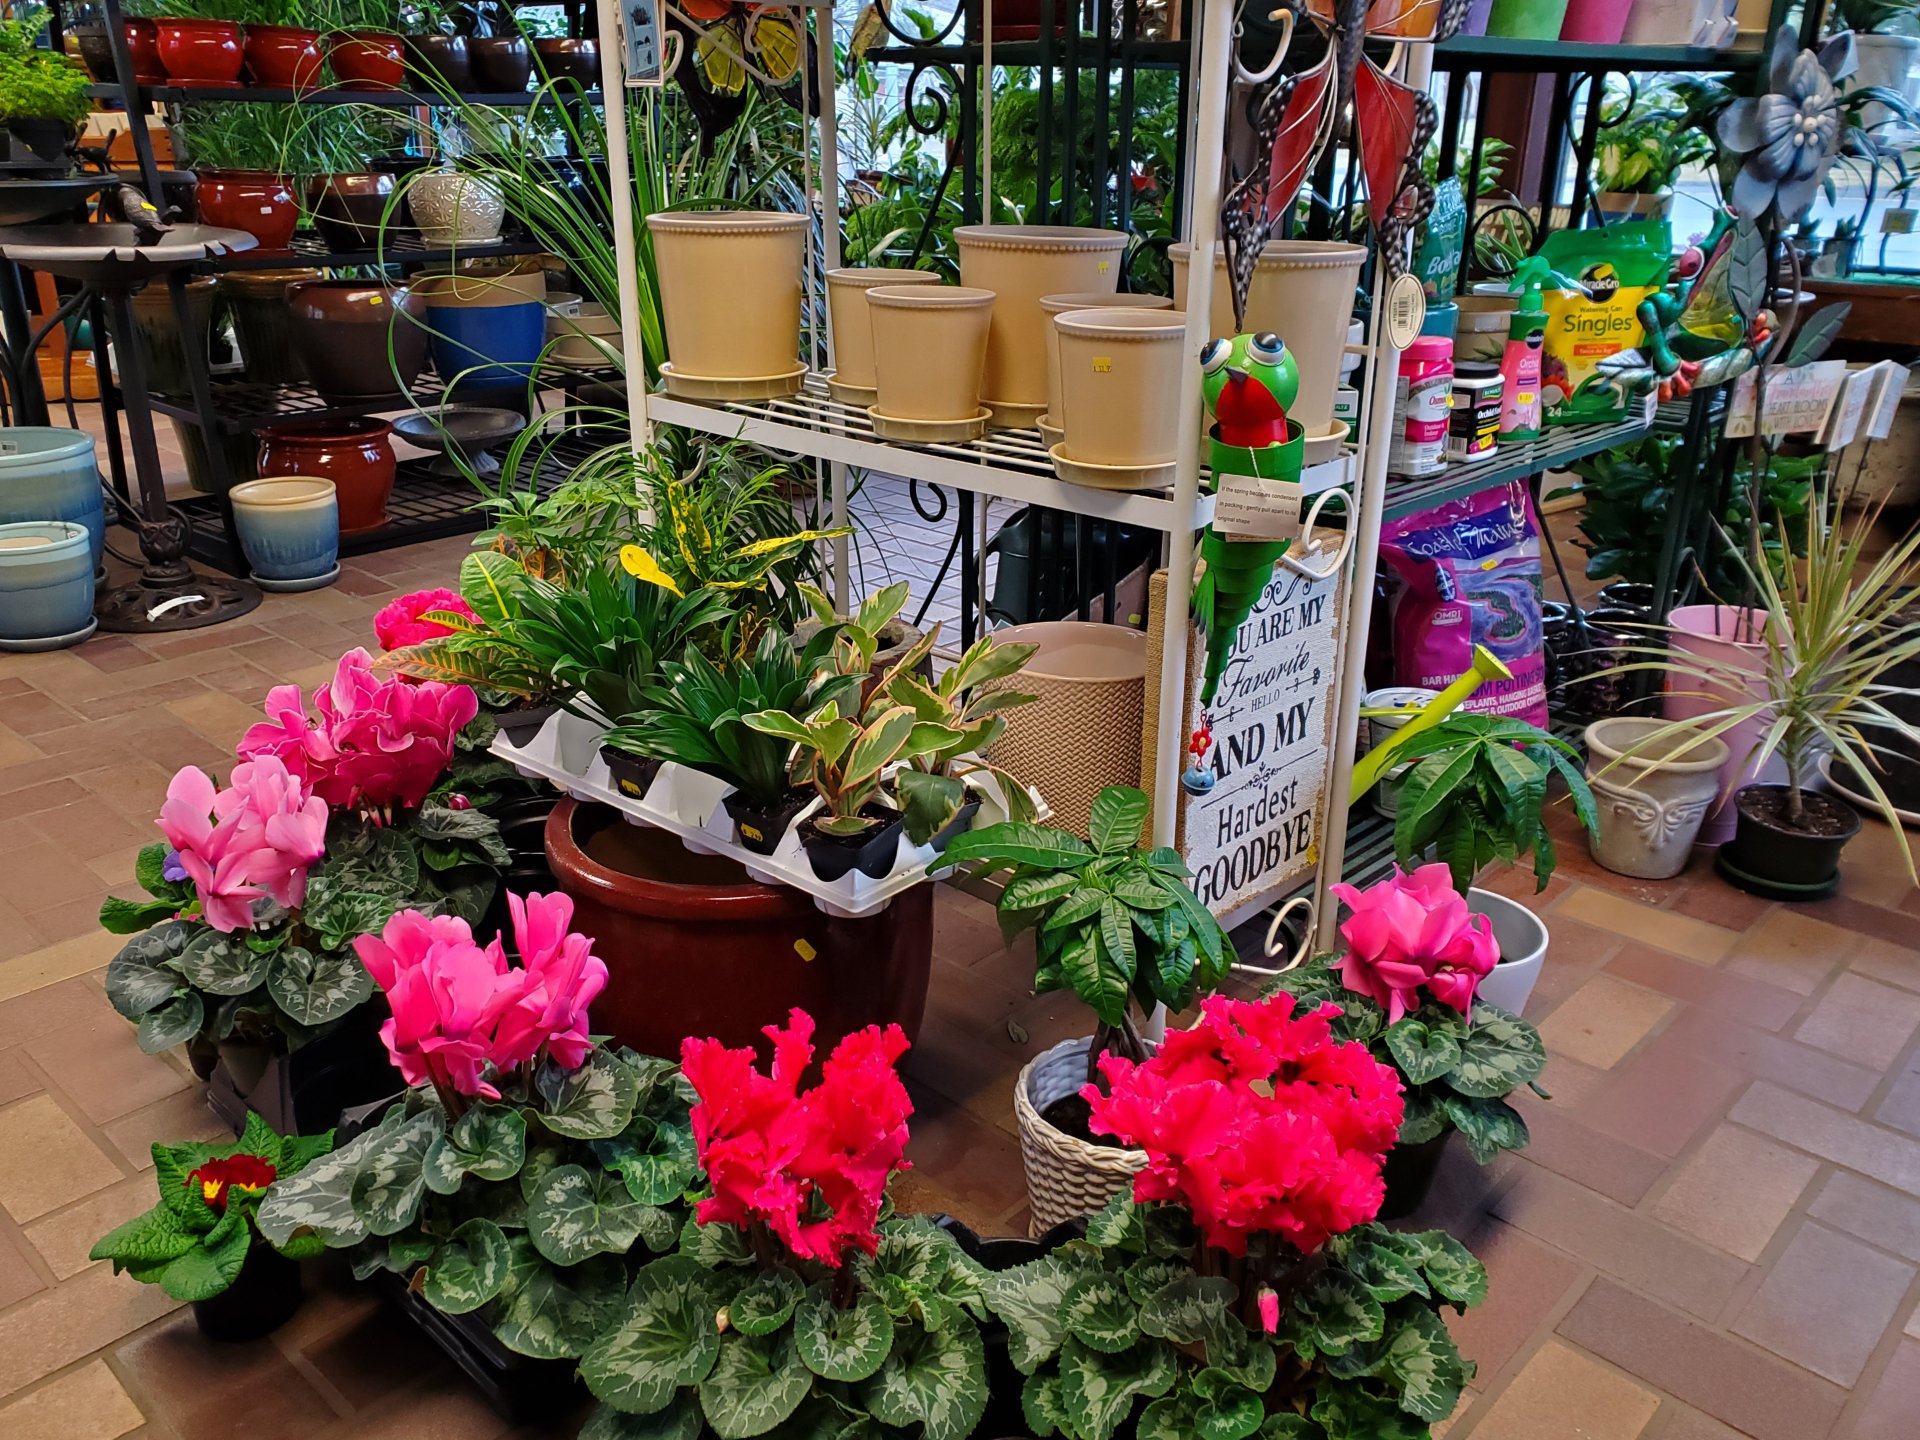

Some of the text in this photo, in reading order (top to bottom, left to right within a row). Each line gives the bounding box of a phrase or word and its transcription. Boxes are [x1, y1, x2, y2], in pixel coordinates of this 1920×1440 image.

[1580, 305, 1609, 314] Watering
[1564, 314, 1633, 336] Singles
[1547, 407, 1562, 417] 24
[1234, 488, 1249, 496] spring
[1271, 493, 1298, 501] condensed
[1225, 502, 1243, 510] packing
[1255, 607, 1294, 648] ARE
[1298, 594, 1326, 631] MY
[1217, 641, 1309, 708] Favorite
[1422, 676, 1442, 685] BAR
[1251, 689, 1280, 712] HELLO
[1500, 690, 1527, 705] HANGING
[1497, 702, 1527, 714] OUTDOOR
[1210, 696, 1316, 781] AND MY
[1217, 776, 1298, 848] Hardest
[1193, 809, 1311, 907] GOODBYE
